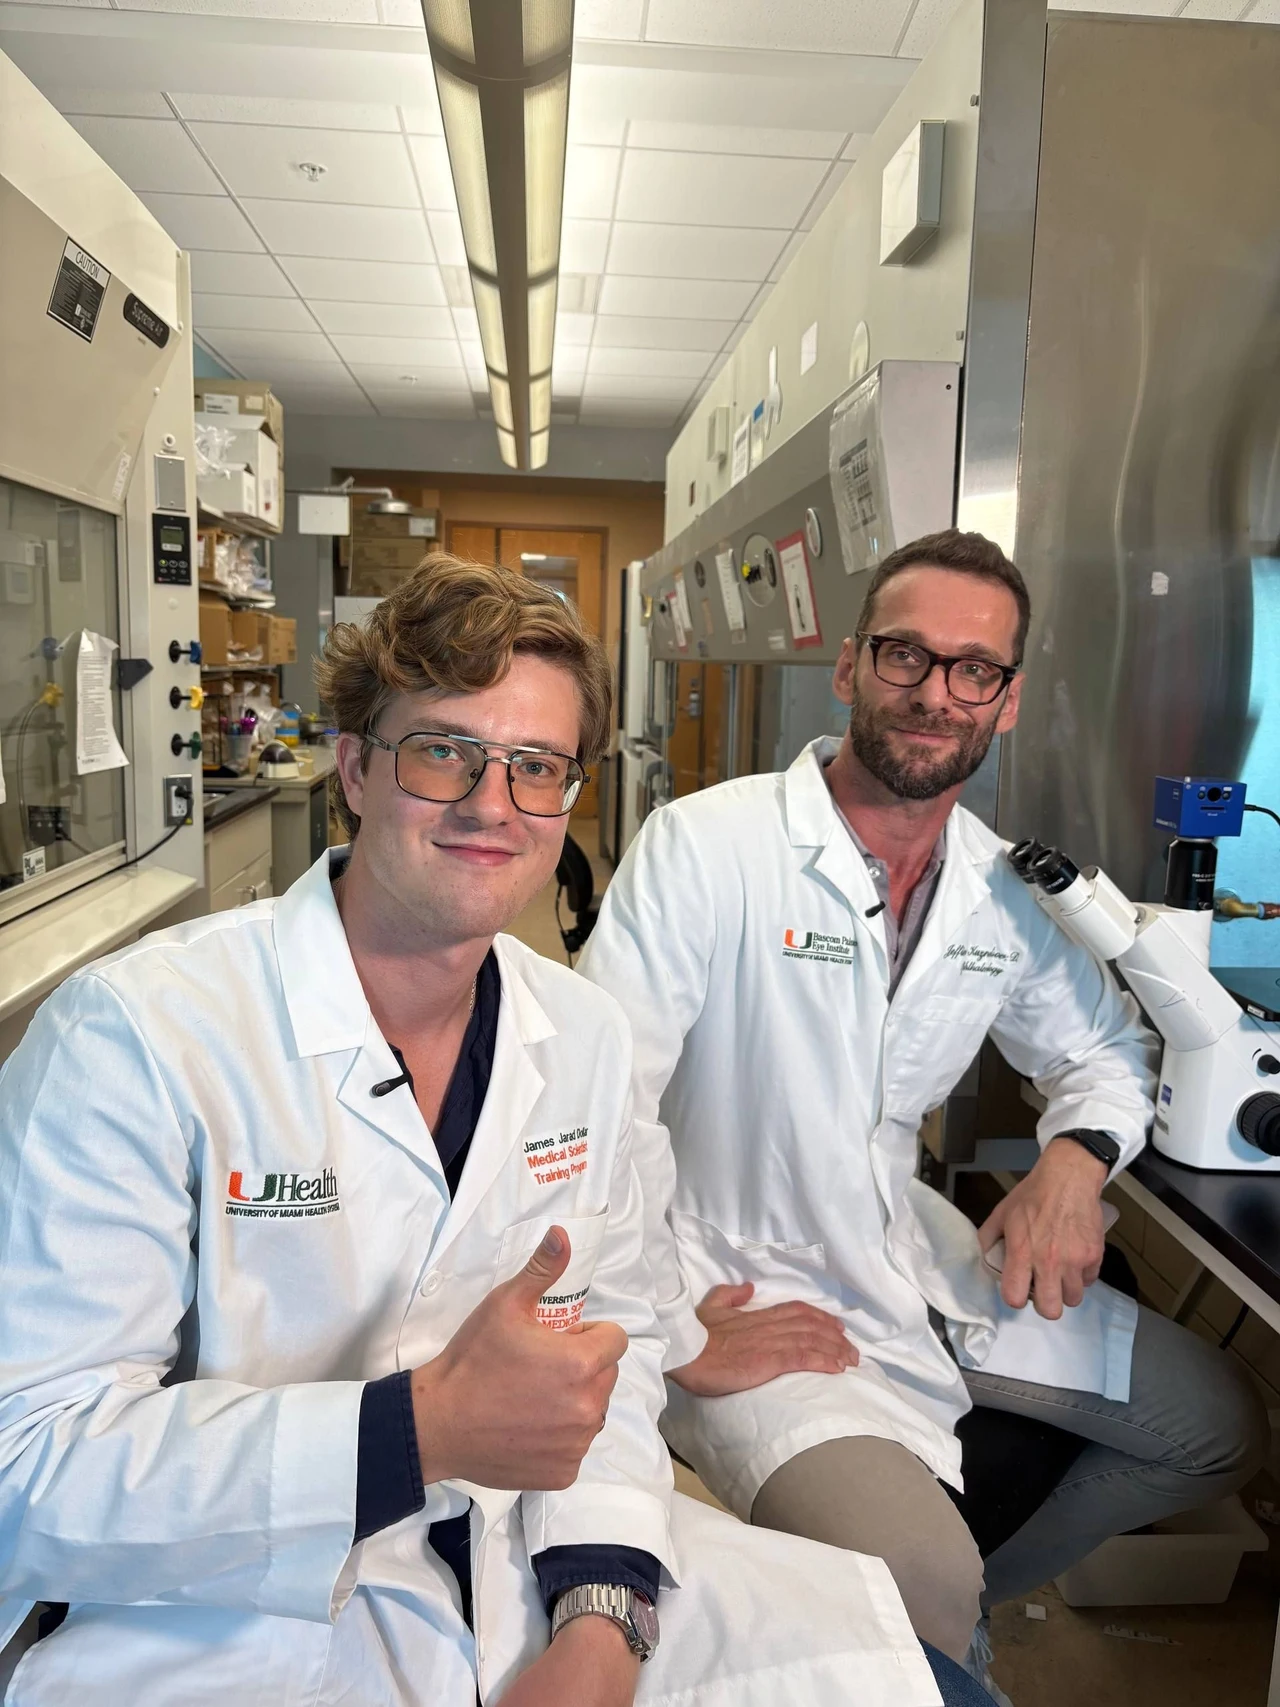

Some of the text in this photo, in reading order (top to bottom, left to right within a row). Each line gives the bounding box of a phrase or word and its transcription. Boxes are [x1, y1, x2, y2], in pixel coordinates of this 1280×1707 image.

[75, 251, 100, 279] CAUTION
[813, 932, 841, 944] Bascom
[812, 941, 825, 951] Eye
[523, 1138, 555, 1153] James
[559, 1129, 576, 1144] Jarad
[527, 1147, 567, 1169] Medical
[534, 1166, 571, 1185] Training
[225, 1206, 267, 1217] UNIVERSITY
[268, 1209, 279, 1218] OF
[280, 1209, 304, 1218] MIAMI
[539, 1294, 574, 1305] IVERSITY
[537, 1308, 568, 1318] ILLER
